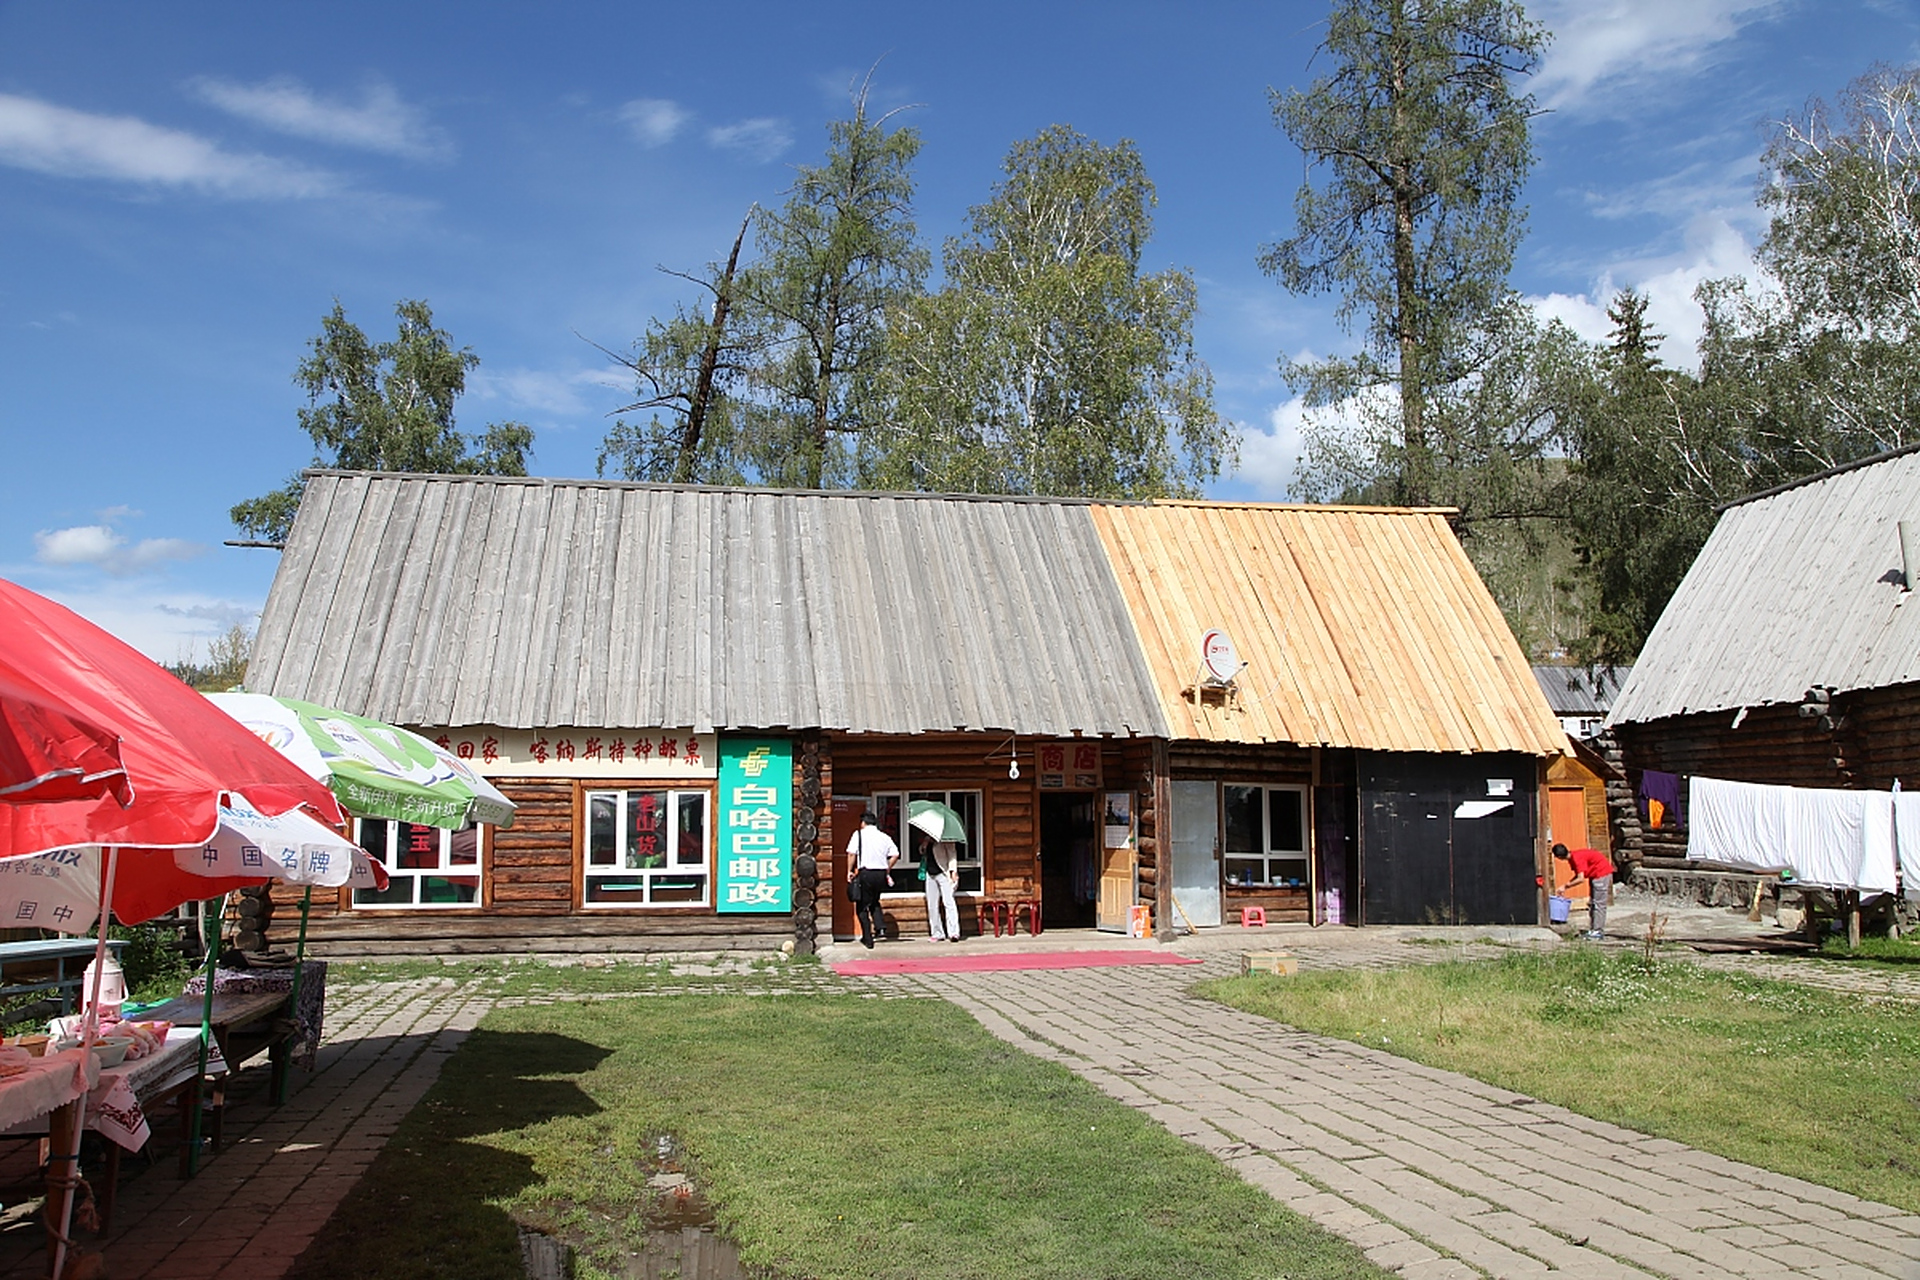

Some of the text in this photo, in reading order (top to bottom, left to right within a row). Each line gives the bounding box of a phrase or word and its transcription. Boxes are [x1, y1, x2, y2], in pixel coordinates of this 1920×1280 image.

[529, 735, 701, 766] 喀纳斯特种邮票
[1041, 744, 1096, 771] 商店
[347, 783, 398, 809] 全新伊利
[402, 795, 457, 818] 全新升级
[203, 845, 330, 874] 中国名牌
[727, 783, 781, 905] 白哈巴邮政
